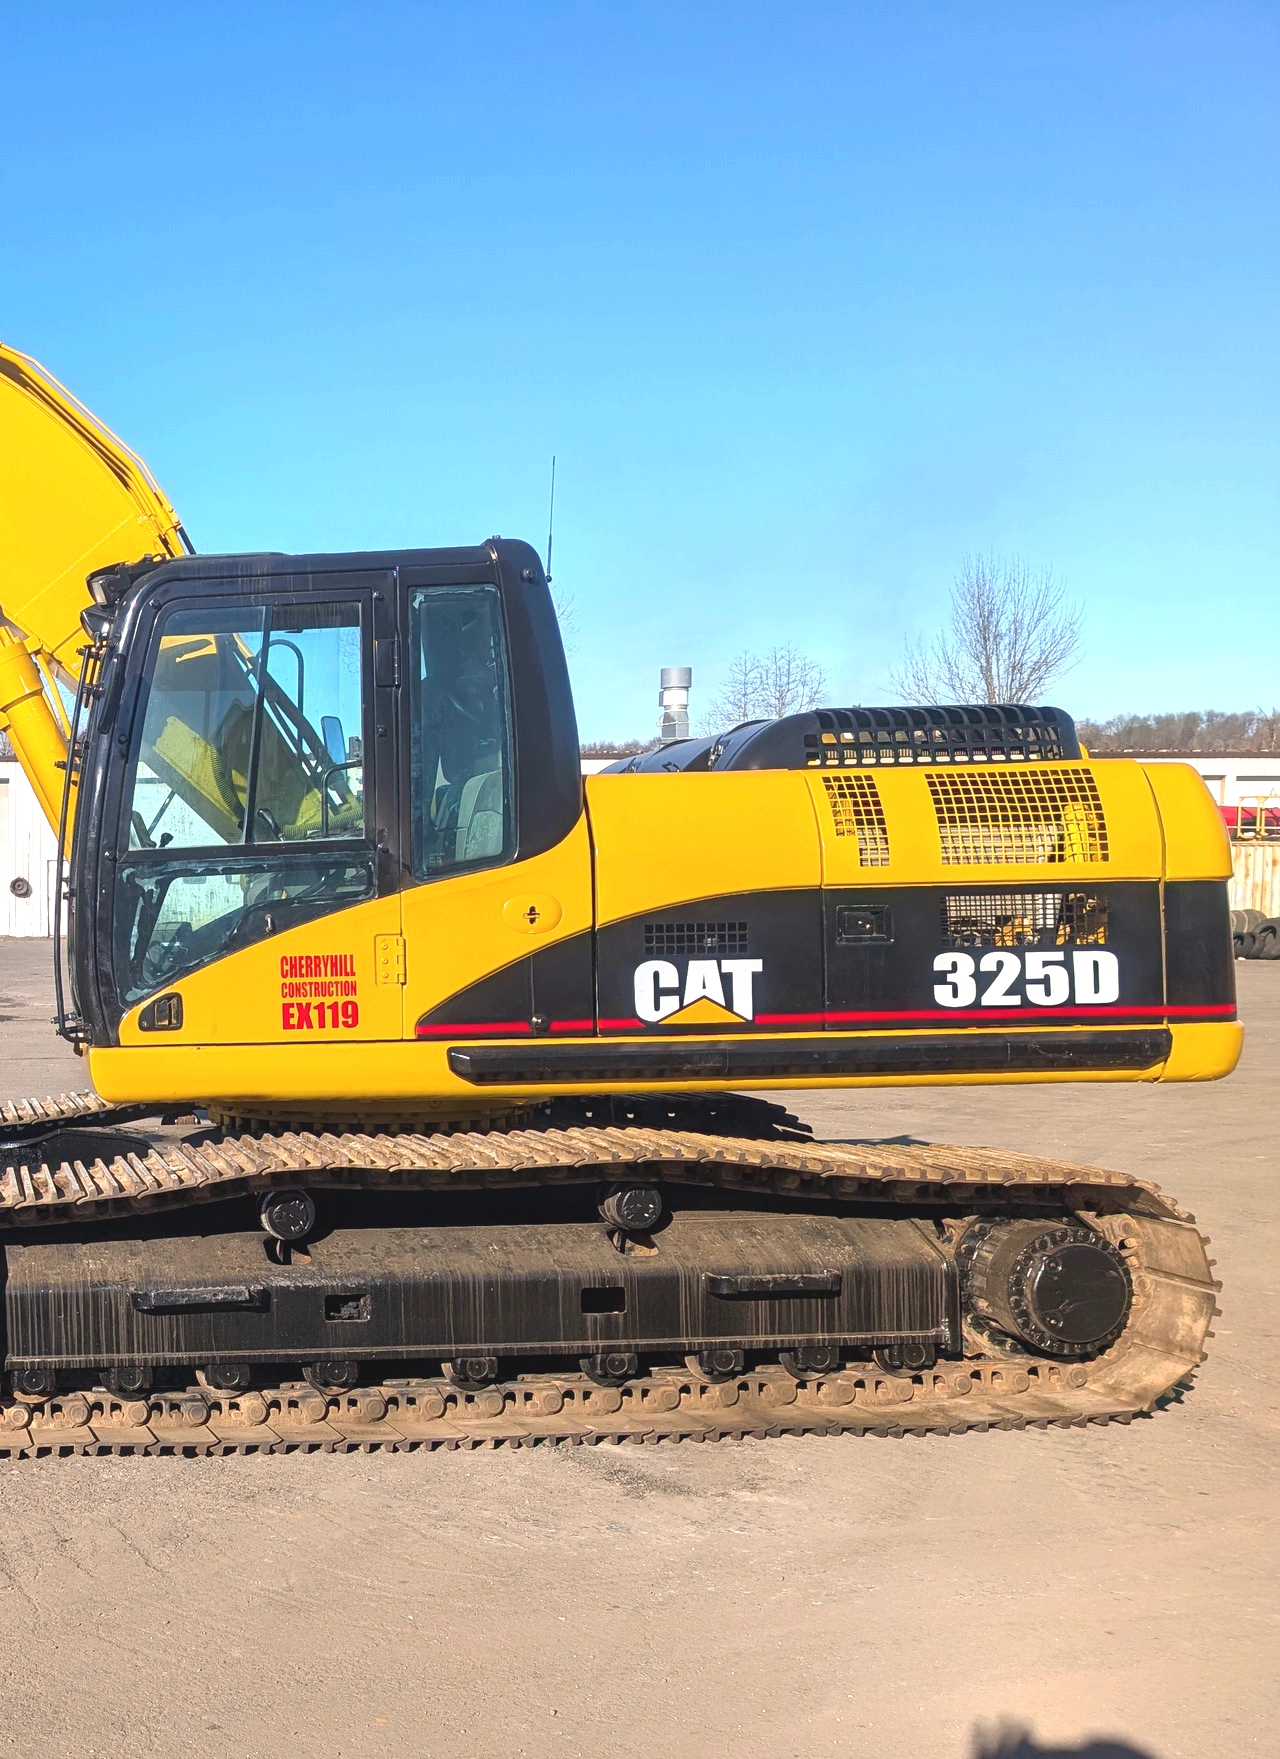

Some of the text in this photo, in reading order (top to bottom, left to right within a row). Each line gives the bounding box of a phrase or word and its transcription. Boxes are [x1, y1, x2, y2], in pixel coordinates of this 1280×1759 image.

[280, 954, 357, 979] CHERRYHILL
[933, 950, 1120, 1008] 325D
[281, 980, 357, 999] CONSTRUCTION
[634, 958, 763, 1022] CAT
[282, 1000, 359, 1030] EX119
